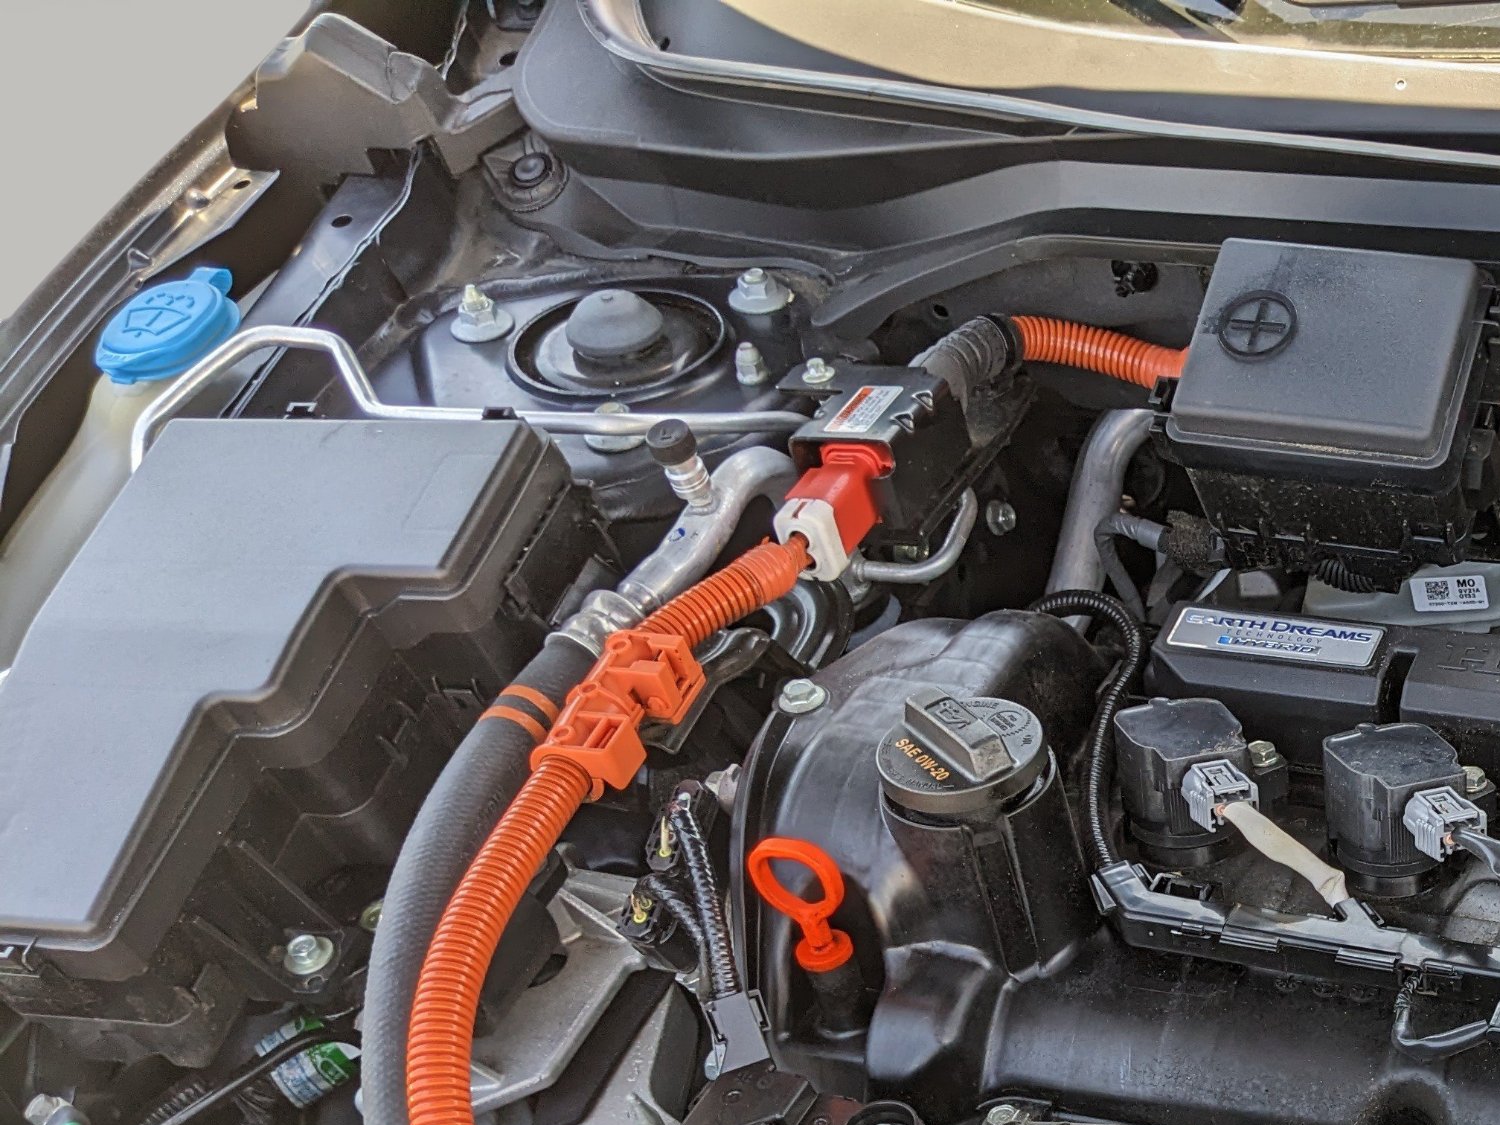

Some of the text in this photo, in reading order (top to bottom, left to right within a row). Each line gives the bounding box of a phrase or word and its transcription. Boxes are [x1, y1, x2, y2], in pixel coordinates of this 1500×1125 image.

[1185, 613, 1374, 643] EARTH DREAMS
[1226, 628, 1322, 644] TECHNOLOGY
[1234, 637, 1317, 653] HYBRID
[895, 738, 923, 758] SAE
